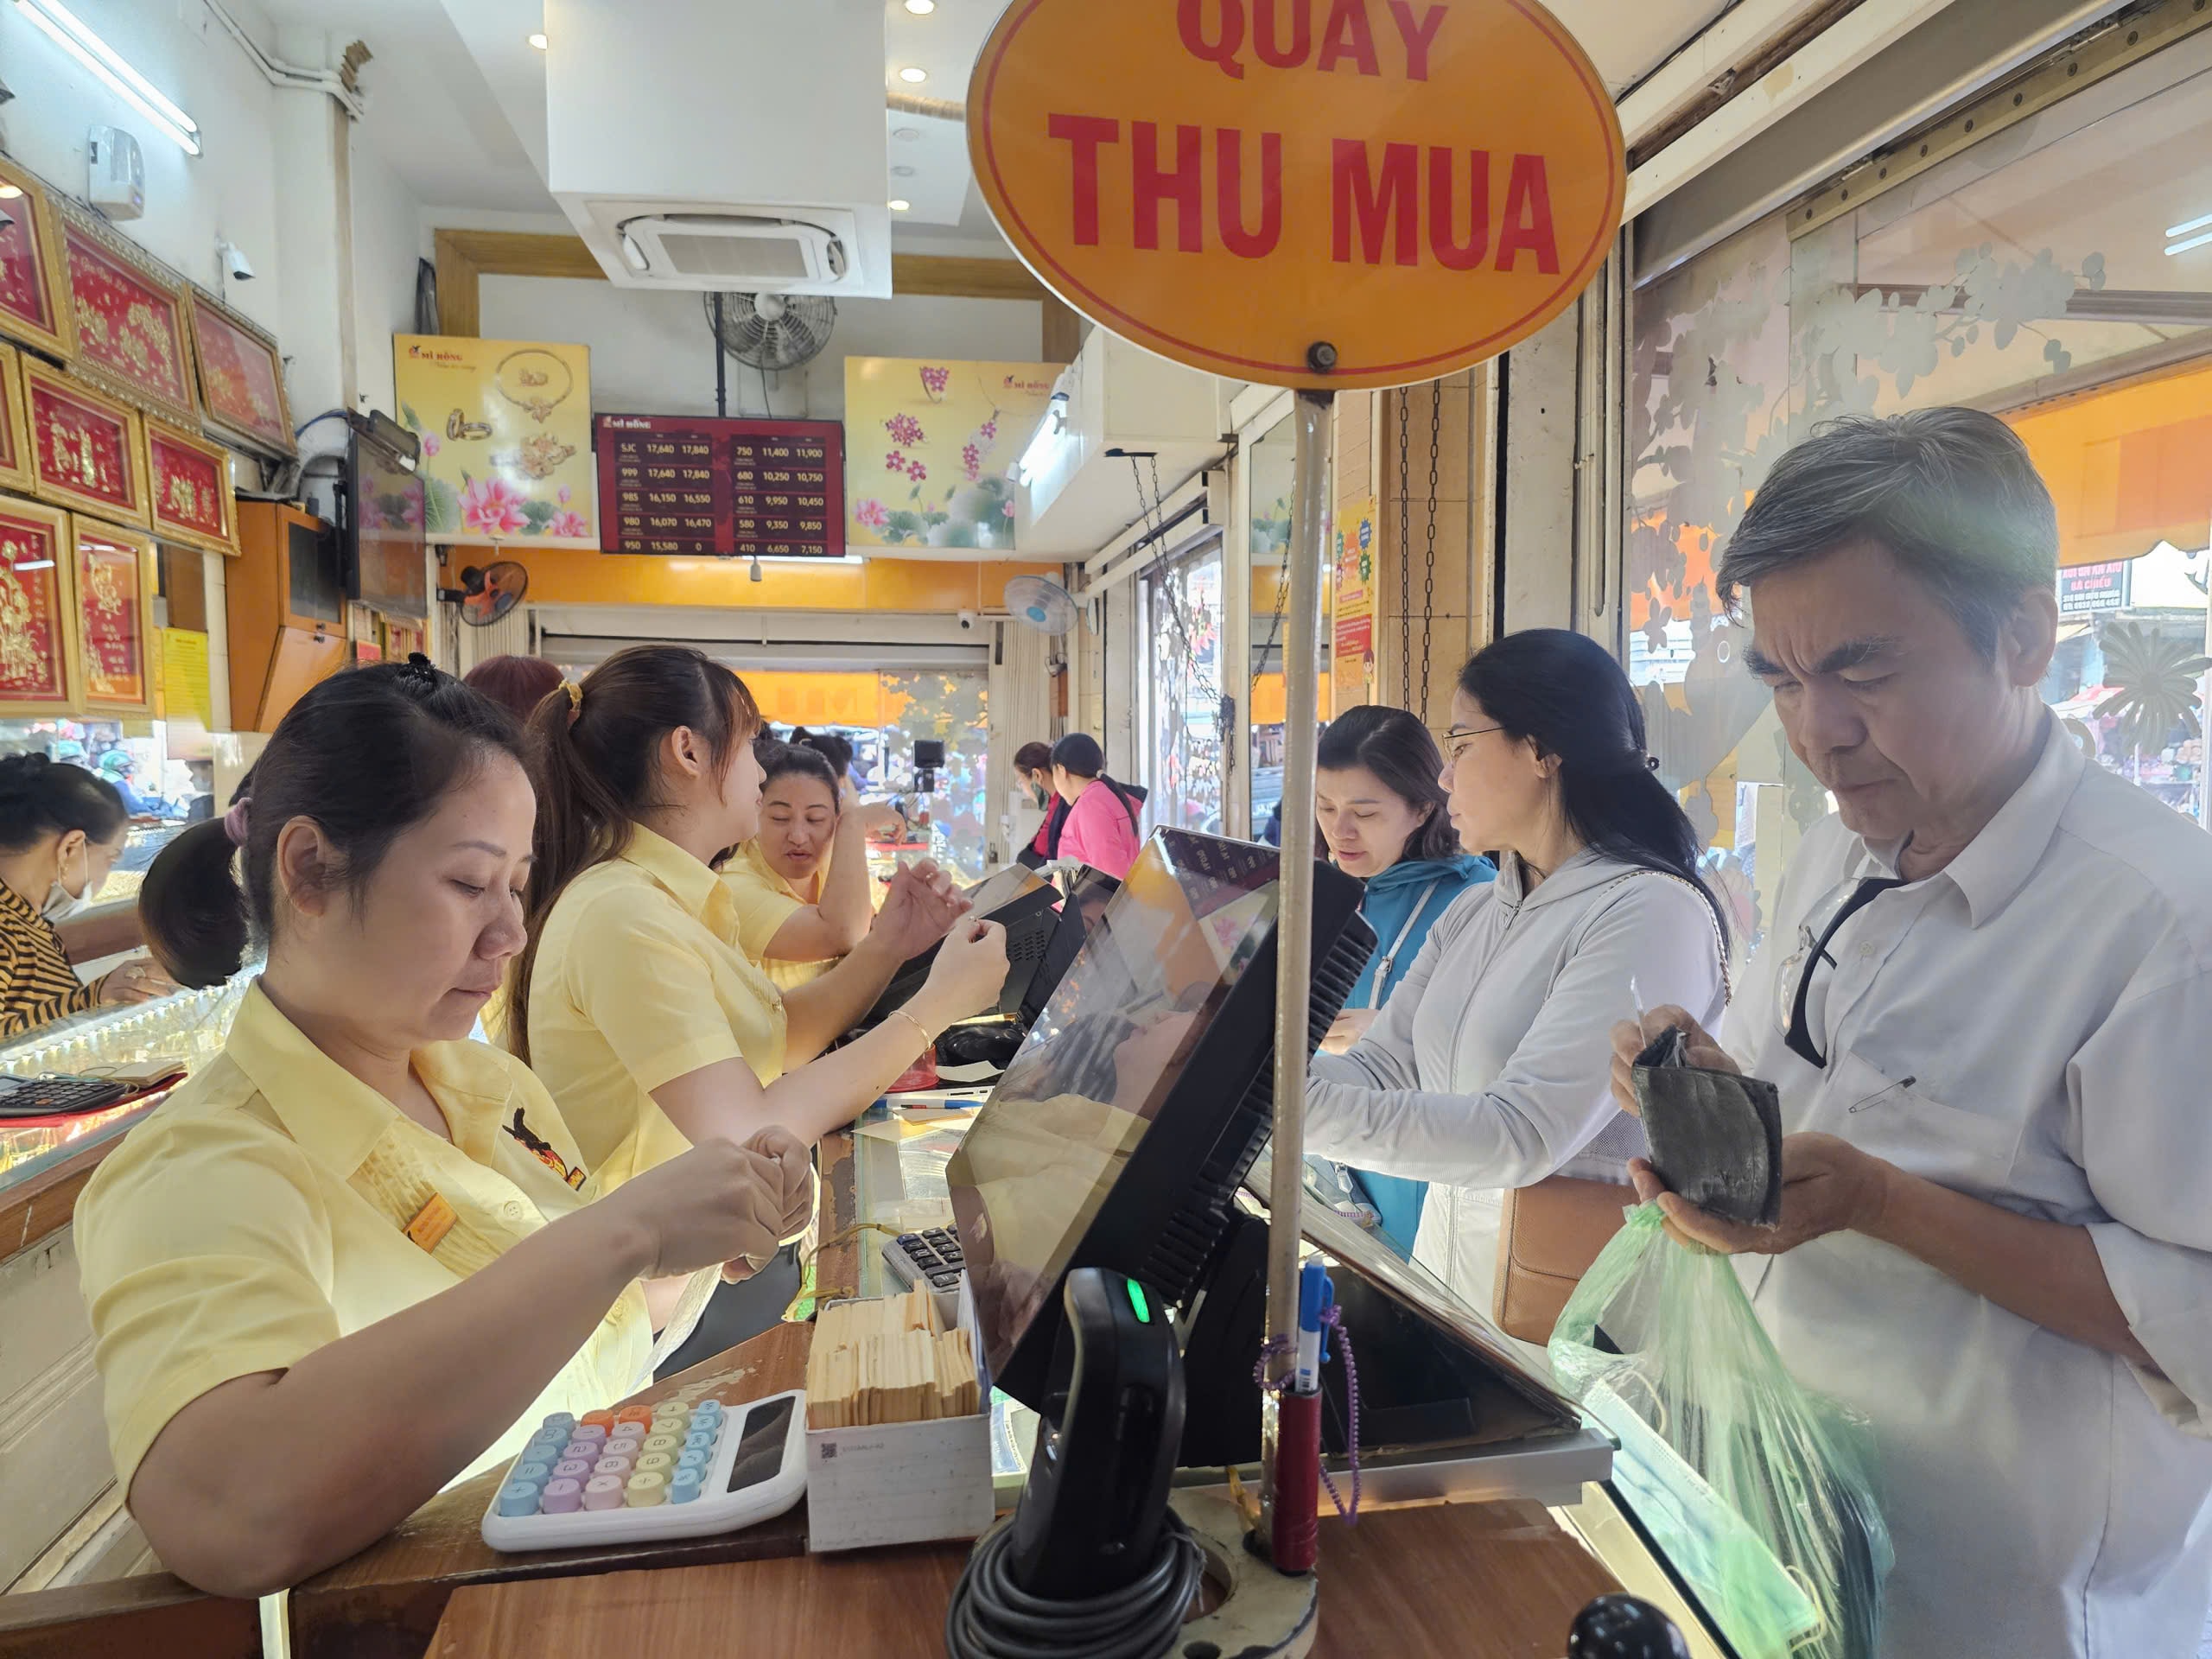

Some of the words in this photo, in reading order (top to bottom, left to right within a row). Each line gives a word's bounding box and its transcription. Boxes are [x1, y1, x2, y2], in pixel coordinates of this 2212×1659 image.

[1048, 113, 1282, 259] THU
[1332, 138, 1560, 275] MUA
[621, 443, 636, 452] SJC
[737, 447, 753, 455] 750
[797, 448, 823, 458] 11,900
[798, 474, 823, 482] 10,750
[622, 493, 639, 501] 985
[650, 493, 676, 503] 16,150
[684, 494, 710, 503] 16,550
[766, 497, 788, 505] 9,950
[798, 498, 823, 506] 10,450
[624, 517, 639, 525] 980
[651, 518, 677, 526] 16,070
[685, 518, 711, 527] 16,470
[766, 520, 788, 530] 9,350
[800, 522, 822, 531] 9,850
[625, 541, 640, 550] 950
[802, 545, 823, 554] 7,150
